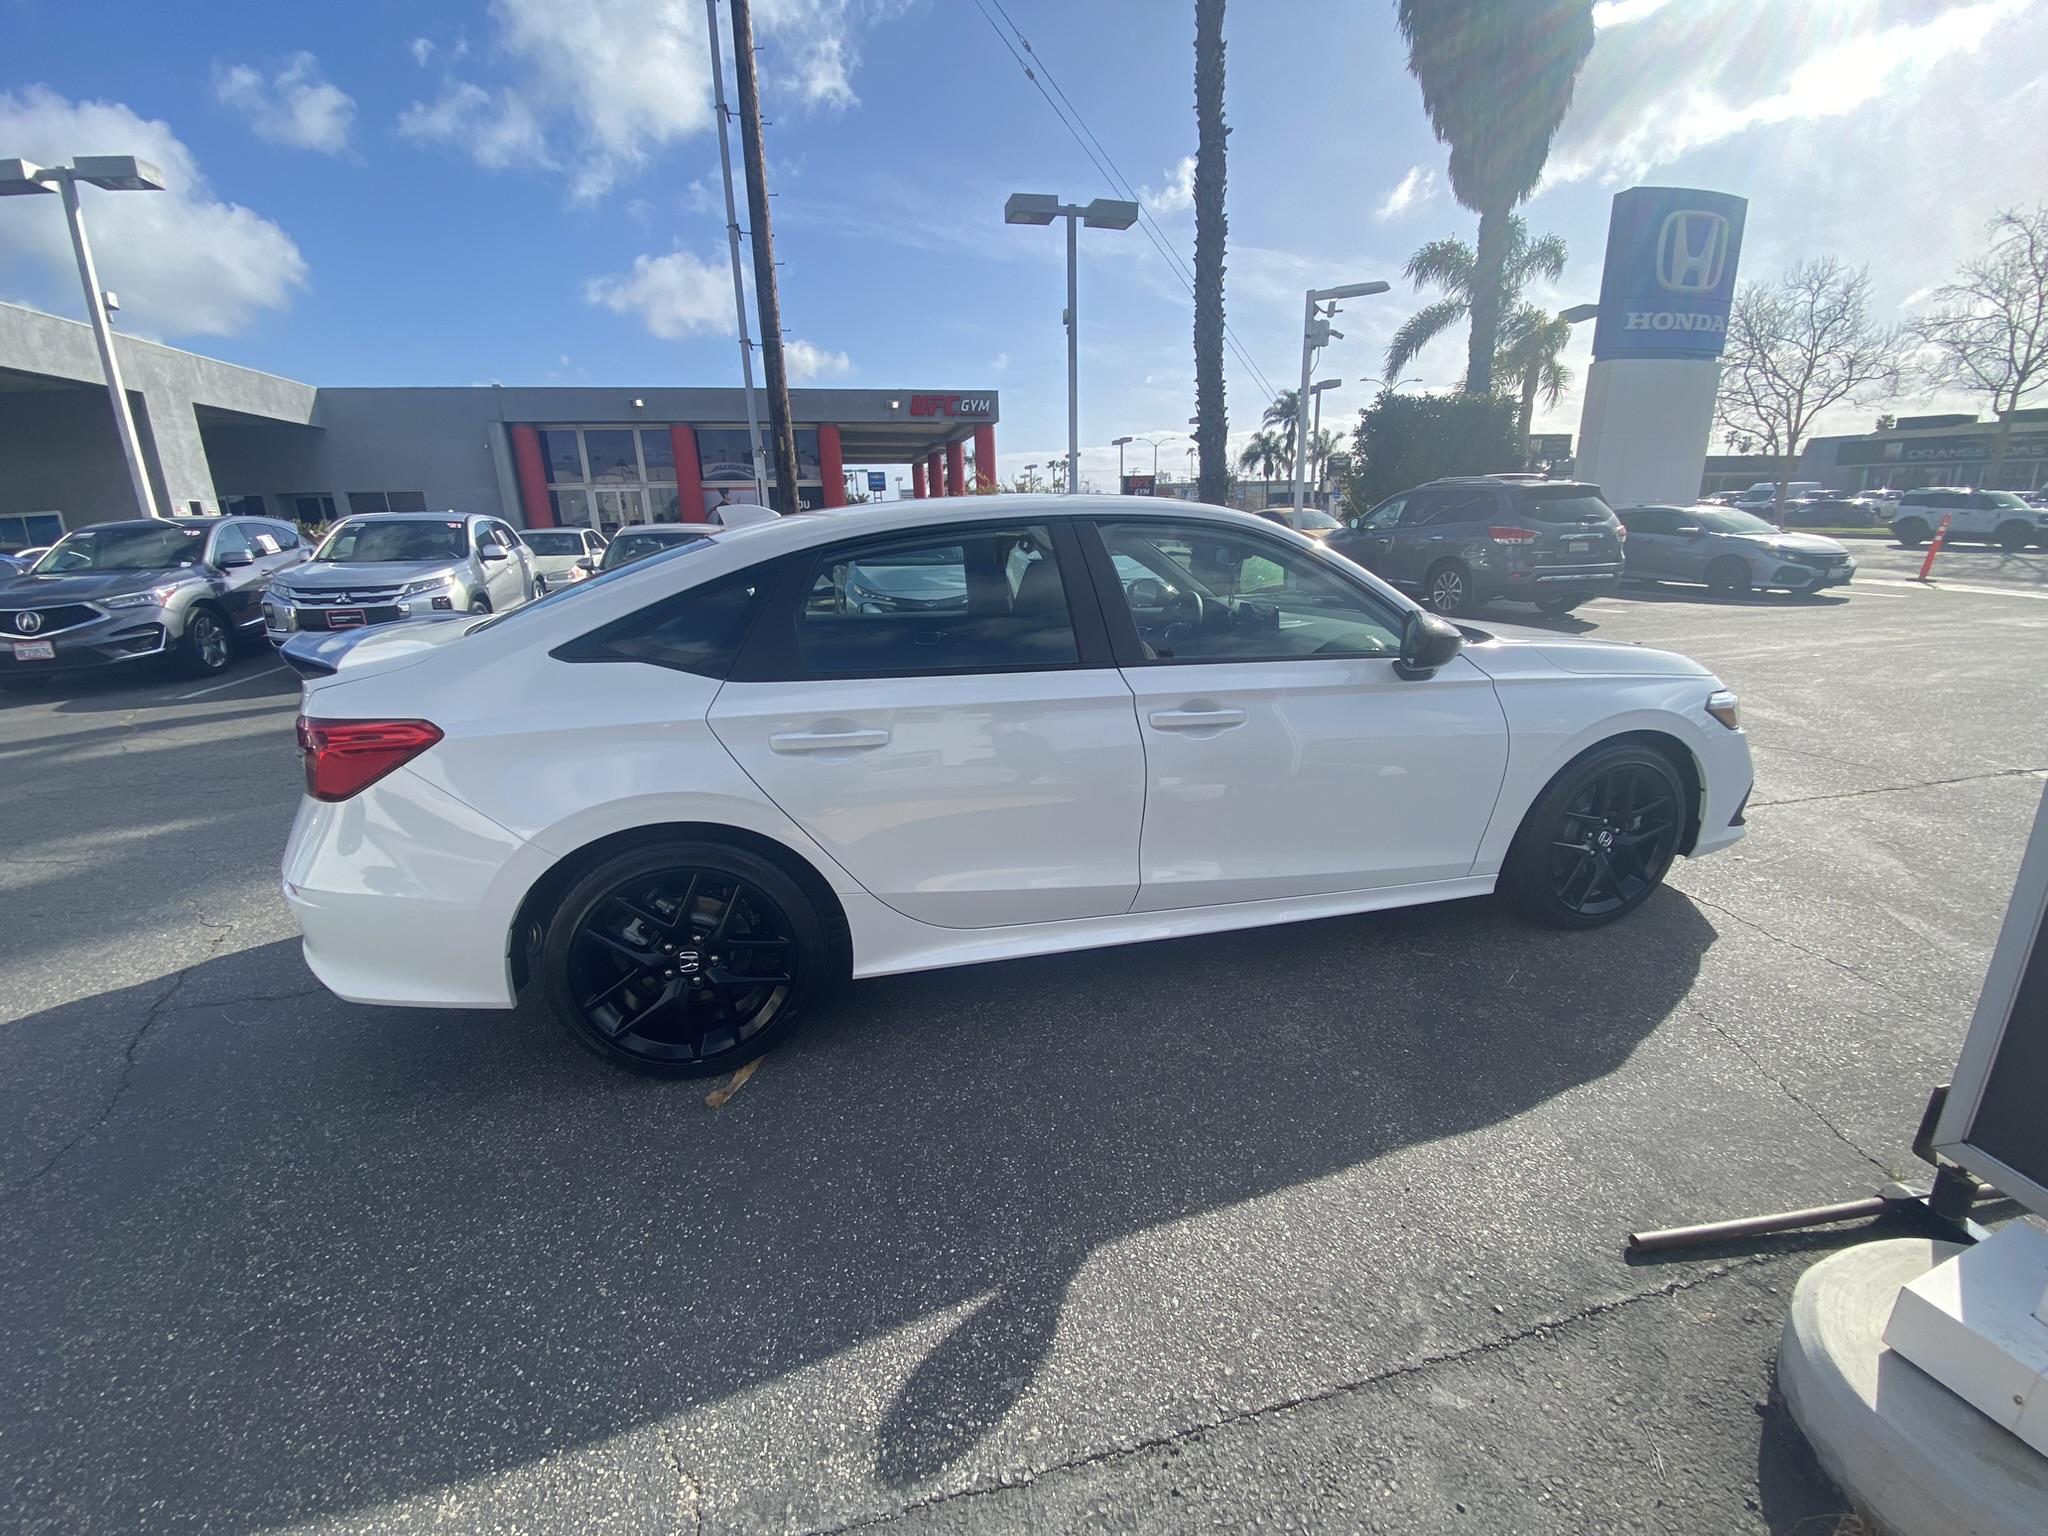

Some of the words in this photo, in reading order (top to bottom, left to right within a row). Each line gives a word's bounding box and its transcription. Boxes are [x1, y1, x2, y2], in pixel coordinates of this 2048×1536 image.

[1624, 311, 1726, 333] HONDA
[910, 394, 961, 417] UFC
[961, 399, 991, 412] GYM
[1907, 447, 1986, 459] ORANGE
[1134, 487, 1150, 496] GYM
